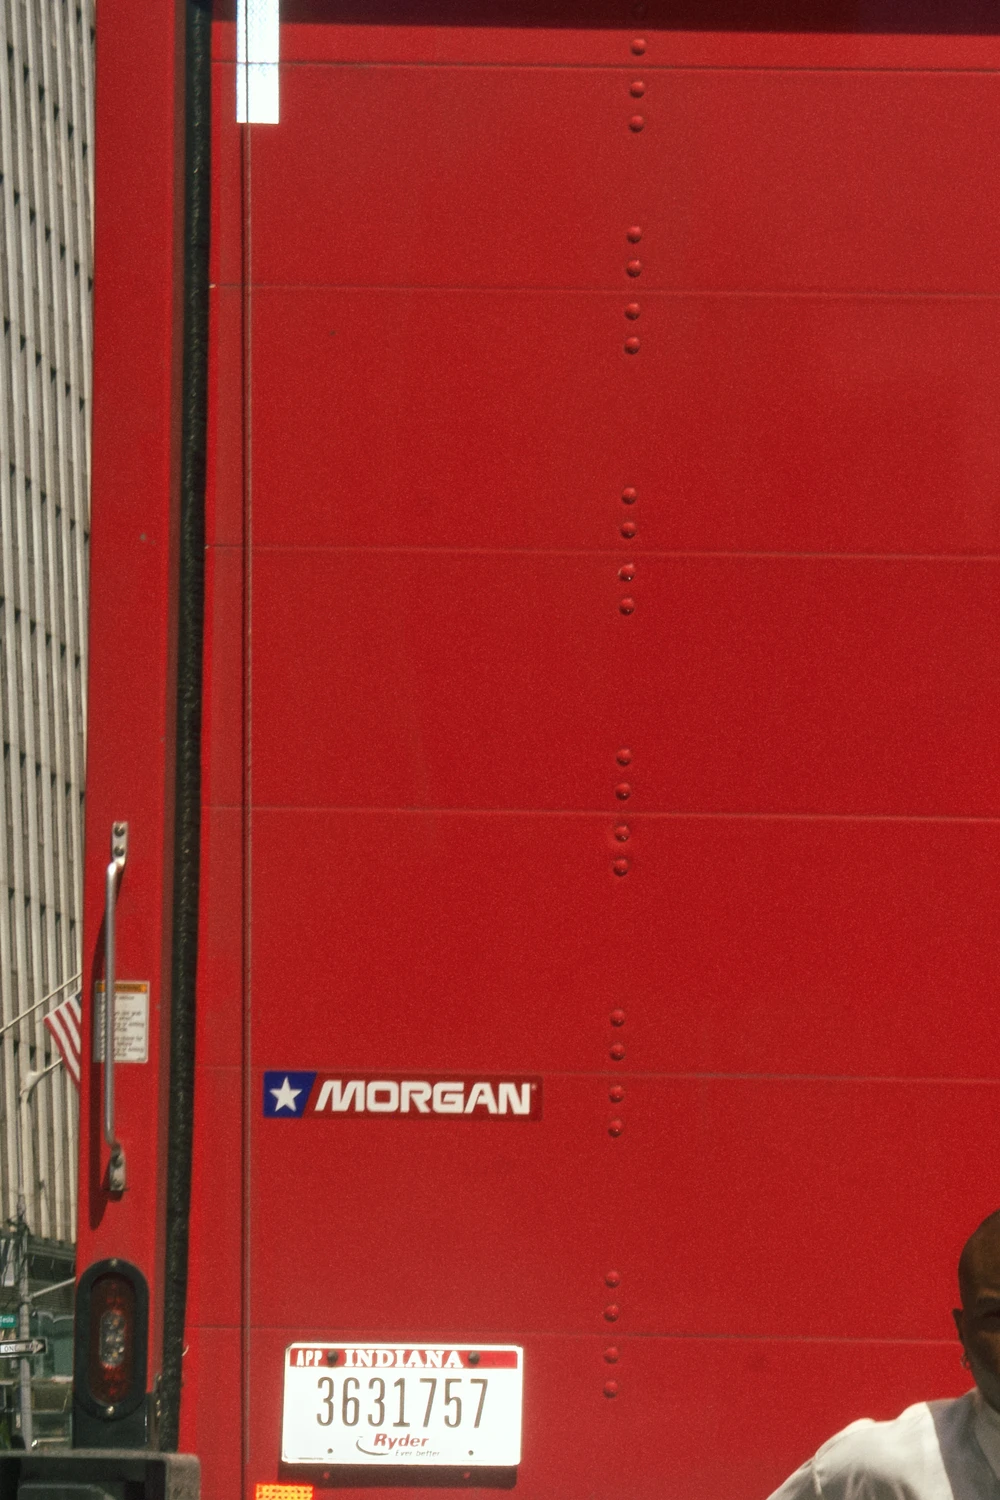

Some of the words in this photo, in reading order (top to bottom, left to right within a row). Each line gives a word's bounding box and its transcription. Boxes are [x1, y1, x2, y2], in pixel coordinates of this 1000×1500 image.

[313, 1079, 532, 1115] MORGAN
[296, 1349, 323, 1367] APP
[344, 1349, 464, 1369] INDIANA
[316, 1376, 489, 1429] 3631757
[373, 1433, 429, 1451] Ryder
[395, 1449, 413, 1457] Ever
[416, 1449, 440, 1458] better
